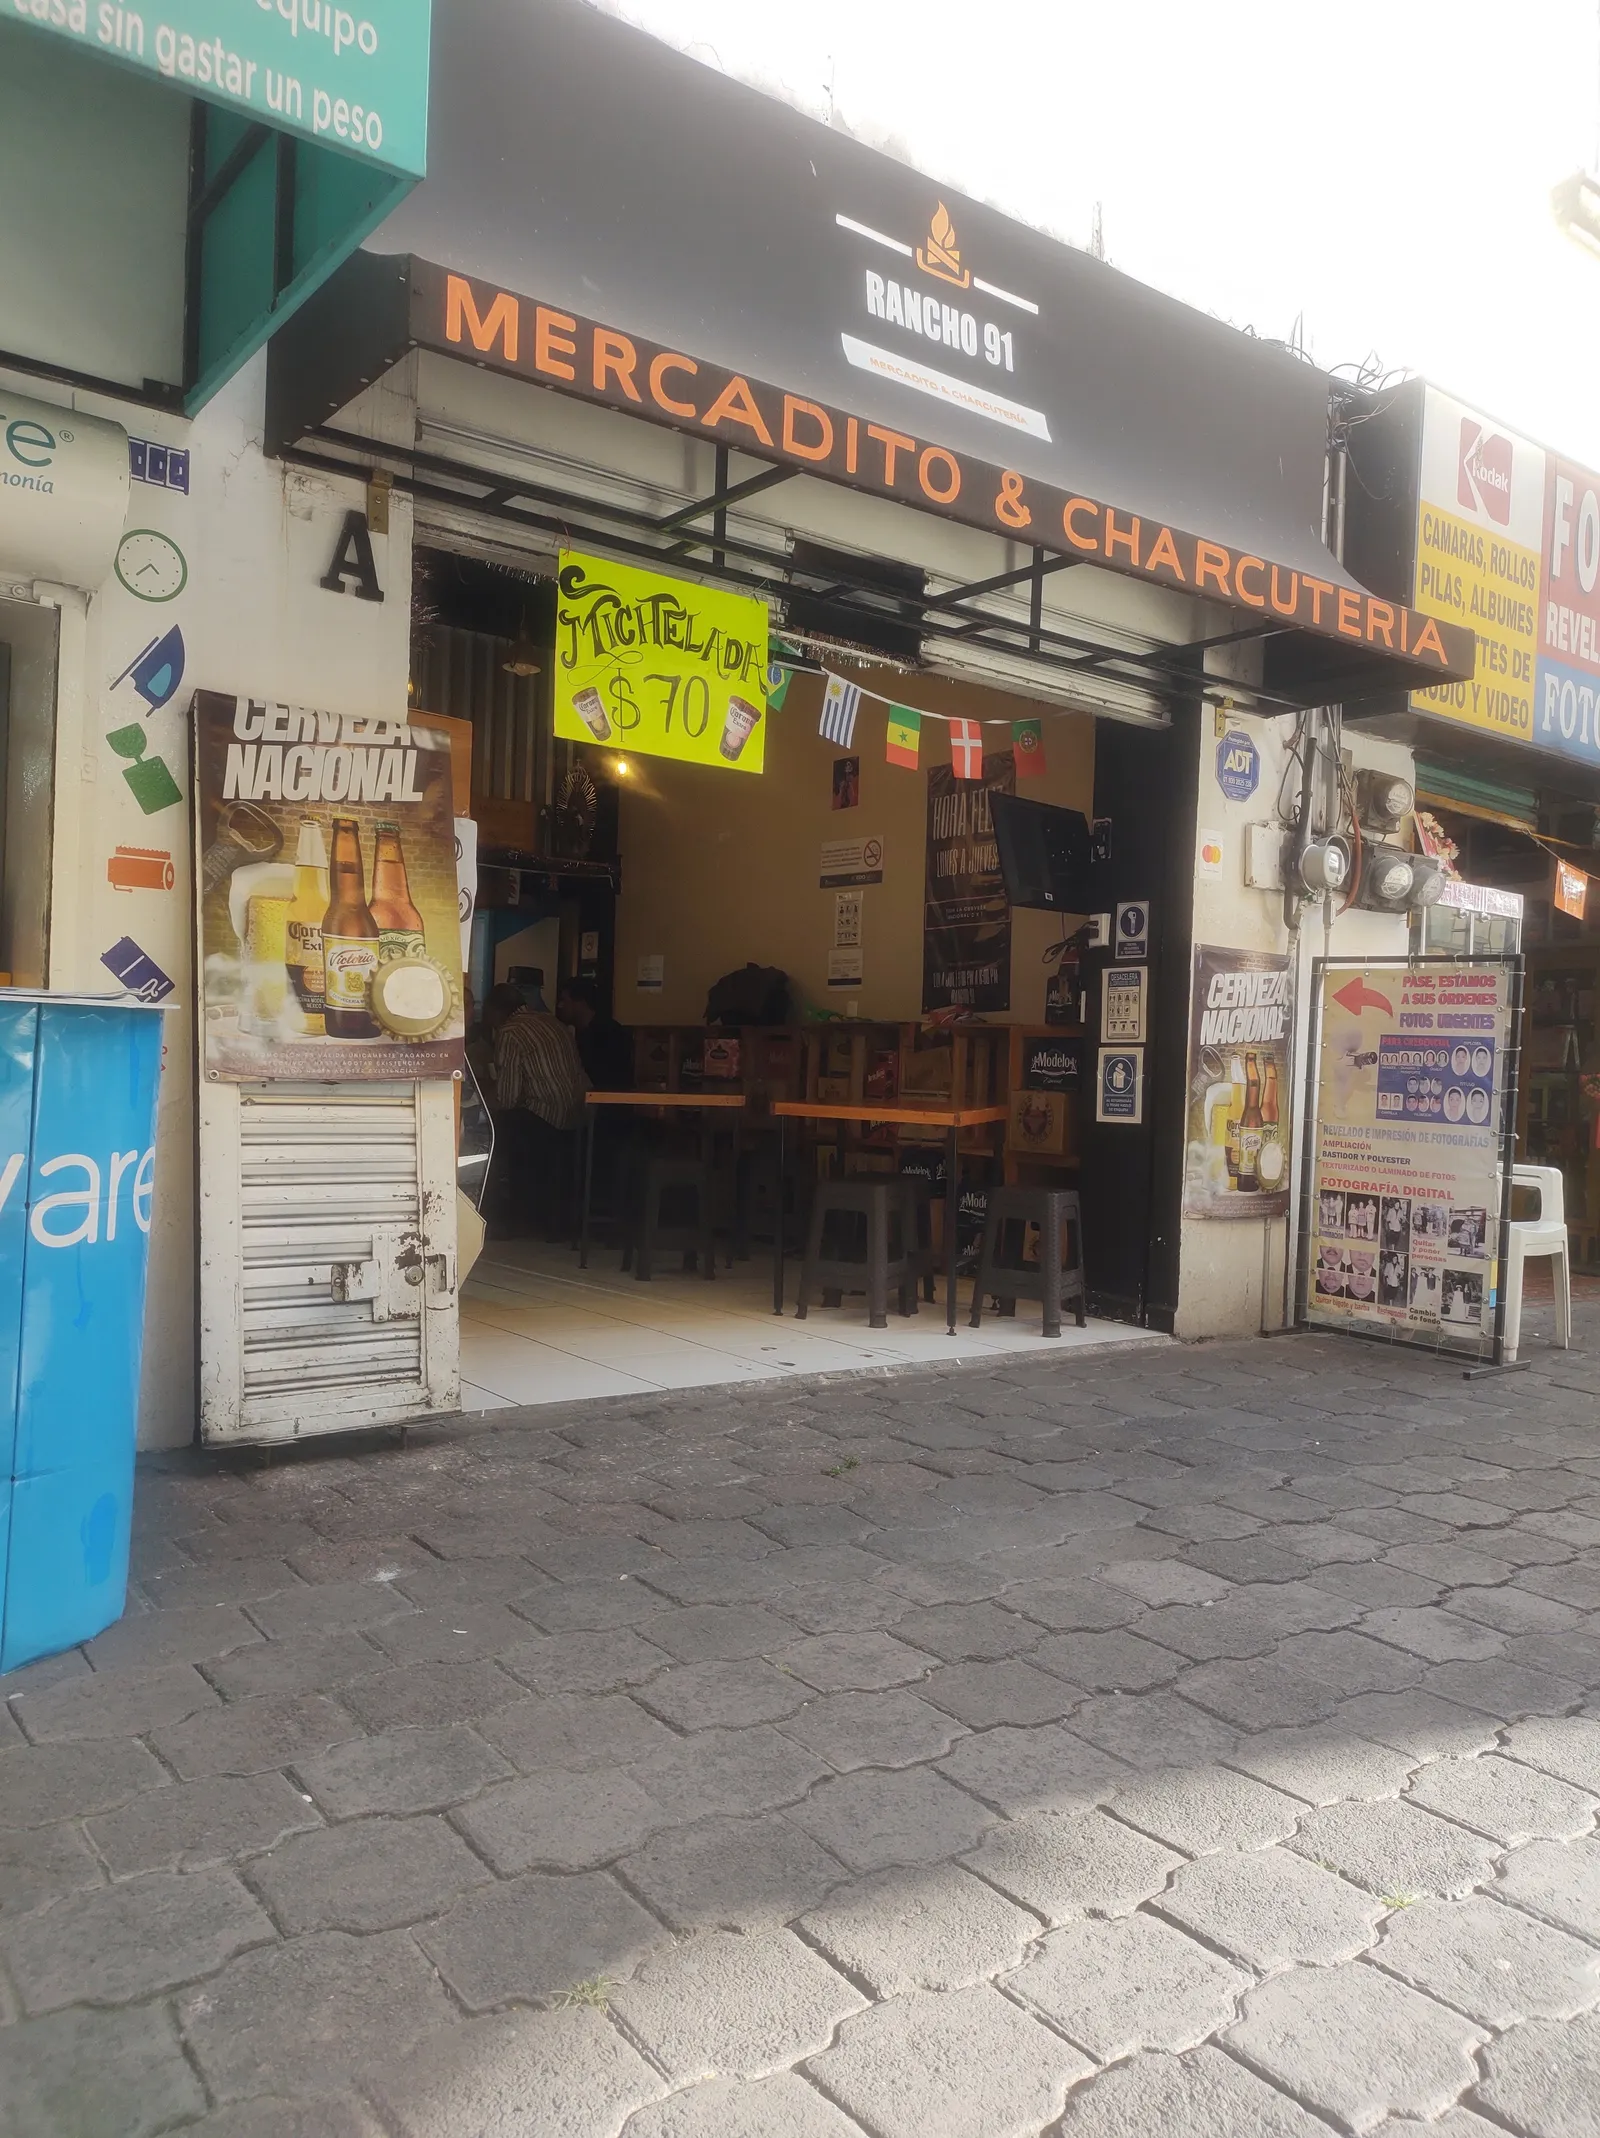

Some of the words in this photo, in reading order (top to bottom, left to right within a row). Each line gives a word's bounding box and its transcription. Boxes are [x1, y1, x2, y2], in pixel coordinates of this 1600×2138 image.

[97, 0, 144, 57] sin
[156, 24, 257, 100] gastar
[266, 68, 302, 120] un
[313, 87, 383, 151] peso
[866, 269, 978, 357] RANCHO
[983, 322, 1014, 373] 91
[869, 356, 939, 391] MERCADITO
[940, 385, 950, 394] &
[951, 389, 1028, 426] CHARCUTERÍA
[445, 273, 962, 505] MERCADITO
[995, 470, 1032, 529] &
[1063, 498, 1450, 666] CHARCUTERIA
[1472, 457, 1509, 493] Kodak
[1423, 512, 1487, 577] CAMARAS,
[1490, 542, 1536, 591] ROLLOS
[1552, 475, 1600, 593] FO
[320, 509, 385, 602] A
[1421, 562, 1465, 617] PILAS,
[1470, 584, 1534, 637] ALBUMES
[558, 592, 769, 697] MICHELADA
[1512, 648, 1531, 683] DE
[1471, 682, 1482, 713] Y
[1485, 686, 1529, 730] VIDEO
[222, 743, 424, 802] NACIONAL
[1223, 748, 1253, 775] ADT
[933, 792, 967, 840] HORA
[971, 785, 1003, 834] FEL
[330, 948, 375, 968] Victoria
[1207, 971, 1288, 1009] CERVEZA
[1401, 993, 1410, 1005] A
[1411, 992, 1436, 1005] SUS
[1438, 989, 1498, 1005] ÓRDENES
[1402, 975, 1436, 990] PASE,
[1438, 975, 1497, 988] ESTAMOS
[1200, 1006, 1284, 1046] NACIONAL
[1400, 1013, 1434, 1028] FOTOS
[1437, 1013, 1496, 1030] URGENTES
[1037, 1051, 1070, 1068] Modelo
[1322, 1139, 1372, 1150] AMPLIACIÓN
[1323, 1124, 1364, 1138] REVELADO
[1365, 1128, 1370, 1138] E
[1371, 1128, 1416, 1143] IMPRESIÓN
[1418, 1133, 1430, 1144] DE
[1431, 1133, 1490, 1148] FOTOGRAFÍAS
[1321, 1161, 1370, 1173] TEXTURIZADO
[1378, 1167, 1418, 1178] LAMINADO
[1419, 1171, 1430, 1179] DE
[1431, 1172, 1457, 1181] FOTOS
[1322, 1150, 1359, 1161] BASTIDOR
[1360, 1153, 1366, 1161] Y
[1367, 1154, 1411, 1165] POLYESTER
[0, 1146, 155, 1247] are
[1320, 1176, 1400, 1195] FOTOGRAFÍA
[1402, 1185, 1455, 1200] DIGITAL
[1412, 1239, 1436, 1248] Quitar
[1409, 1307, 1437, 1317] Cambio
[1419, 1316, 1441, 1325] fondo
